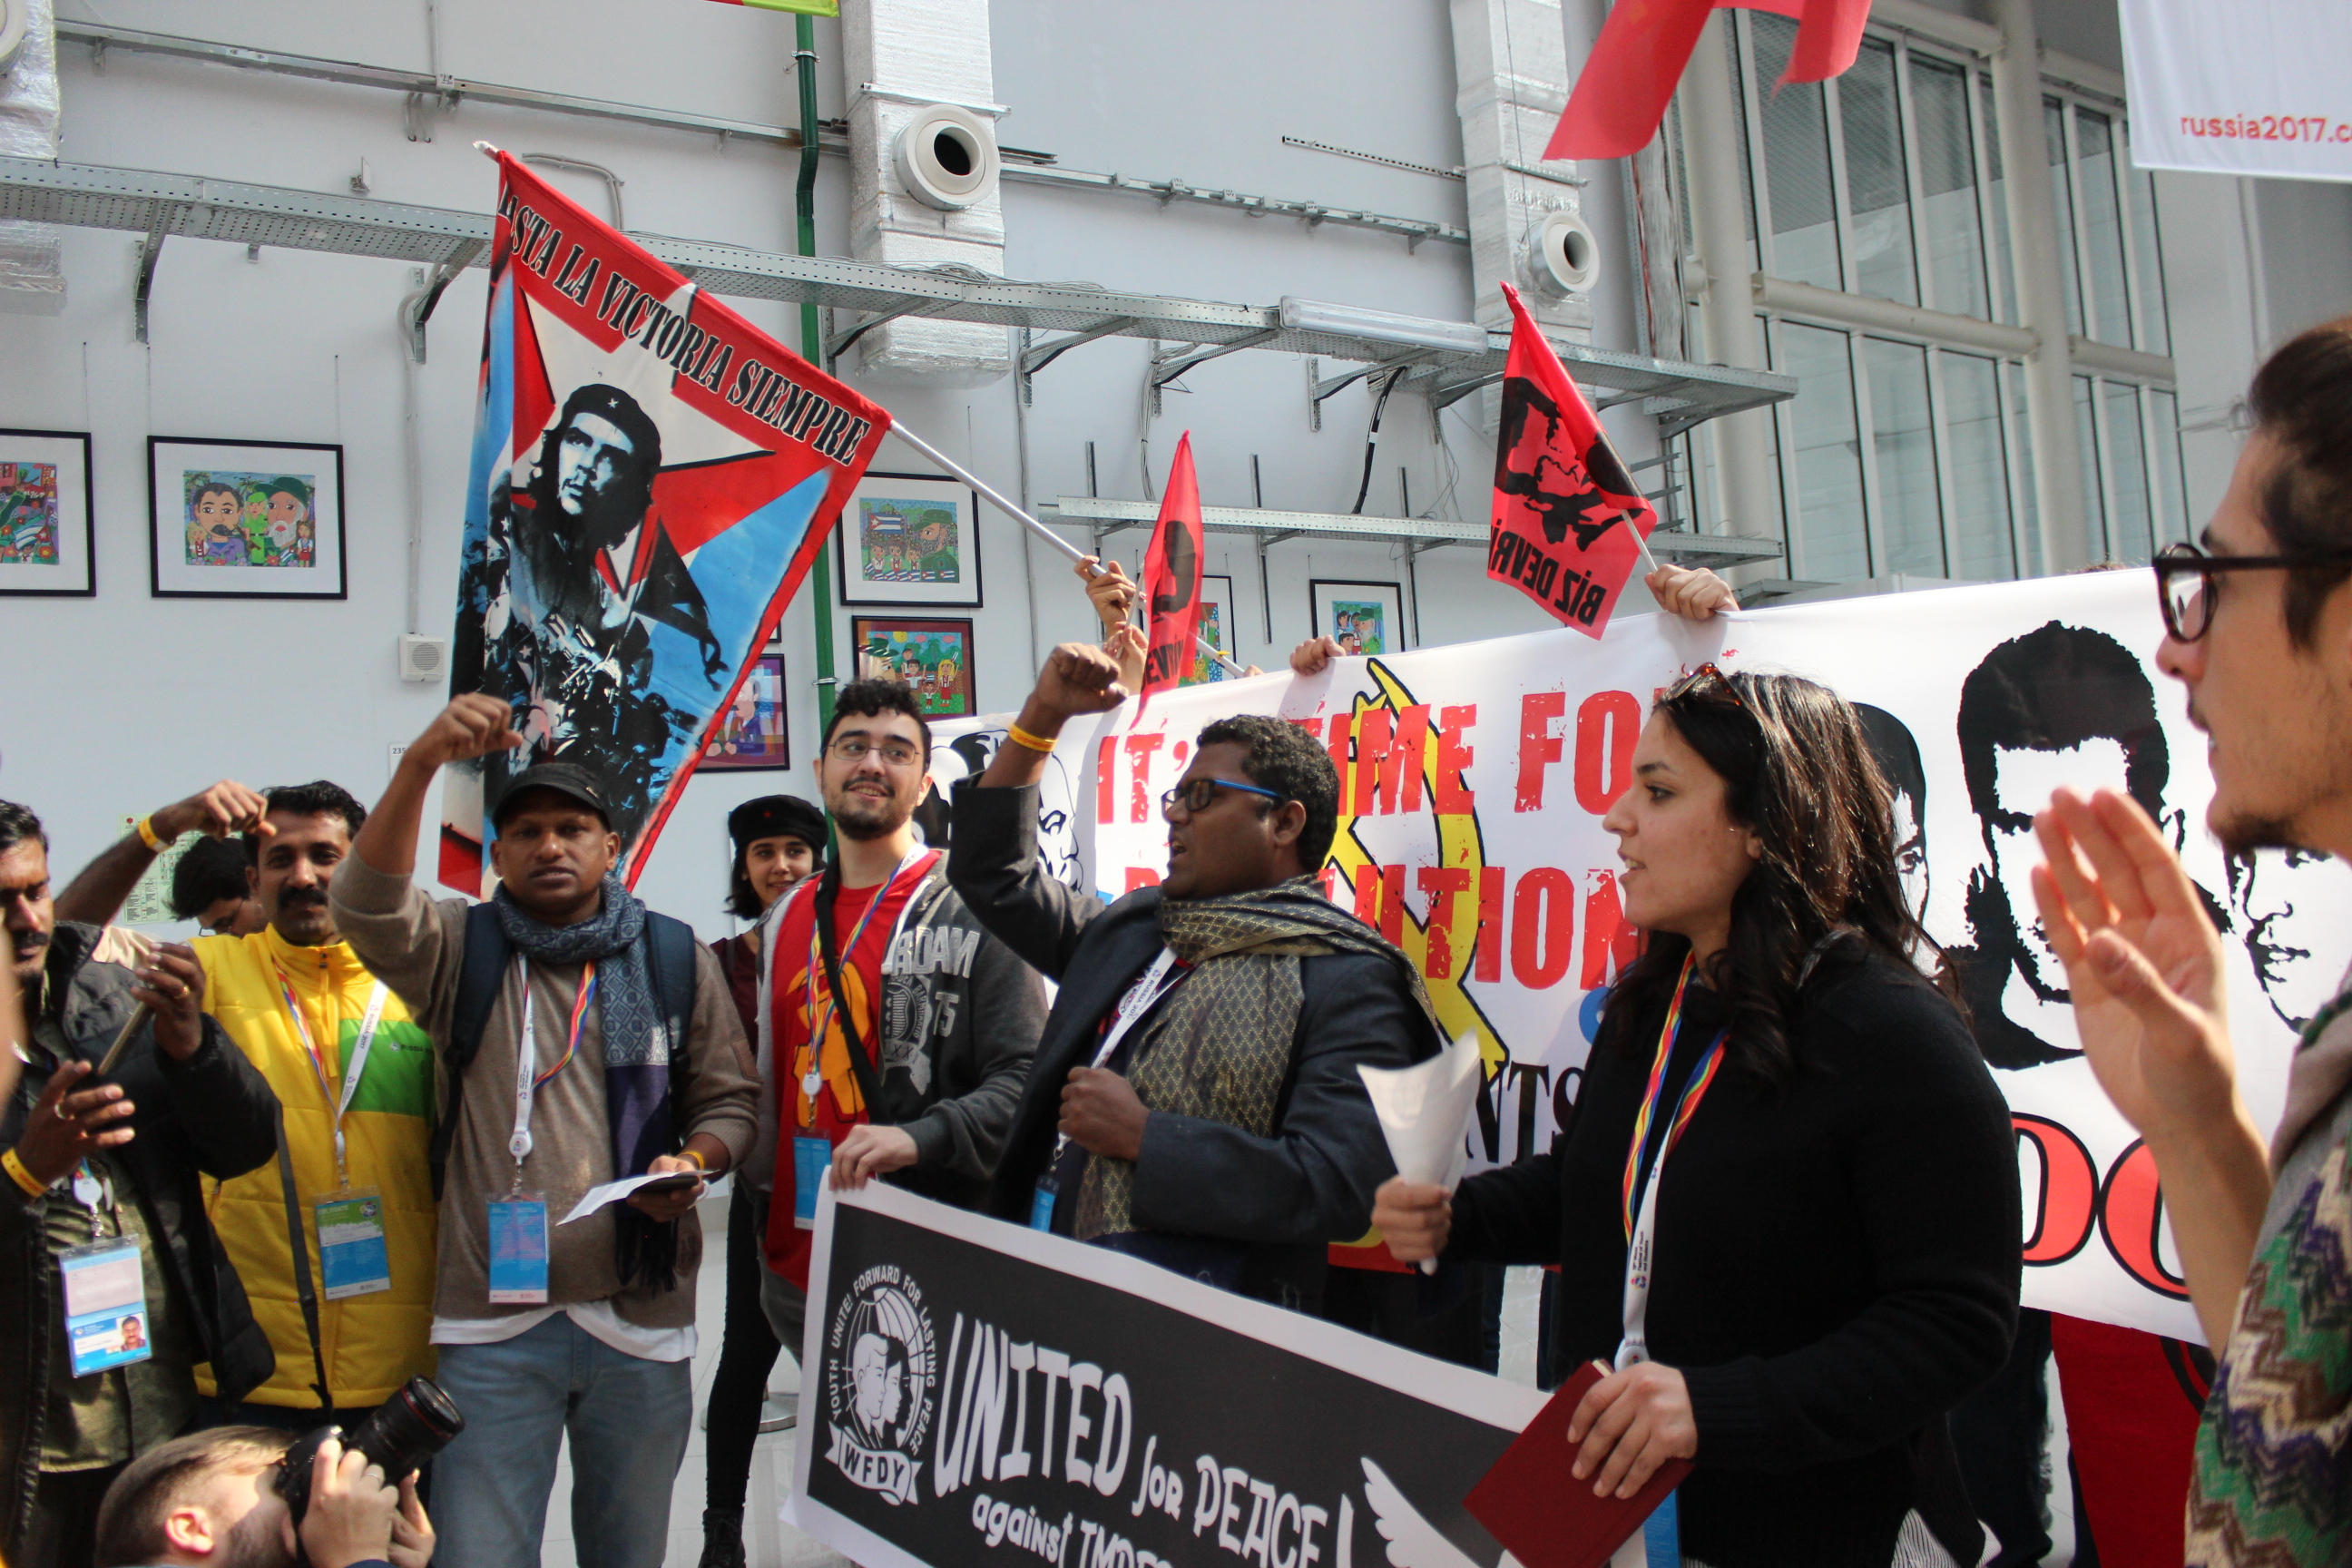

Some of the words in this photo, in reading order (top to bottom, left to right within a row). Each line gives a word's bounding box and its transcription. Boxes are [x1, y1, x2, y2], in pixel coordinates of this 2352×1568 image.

[2180, 113, 2352, 143] russia2017.c
[553, 244, 600, 307] LA
[597, 271, 733, 394] VICTORIA
[726, 359, 871, 466] SIEMPRE
[1097, 732, 1189, 825] IT'
[1286, 703, 1477, 817] IME
[1514, 688, 1670, 816] FO
[853, 1265, 900, 1297] FORWARD
[904, 1274, 922, 1308] FOR
[831, 1294, 854, 1348] UNITE!
[919, 1307, 936, 1387] LASTING
[829, 1359, 841, 1420] YOUTH
[935, 1312, 1132, 1497] UNITED
[909, 1396, 933, 1456] PEACE
[843, 1442, 905, 1489] WFDY
